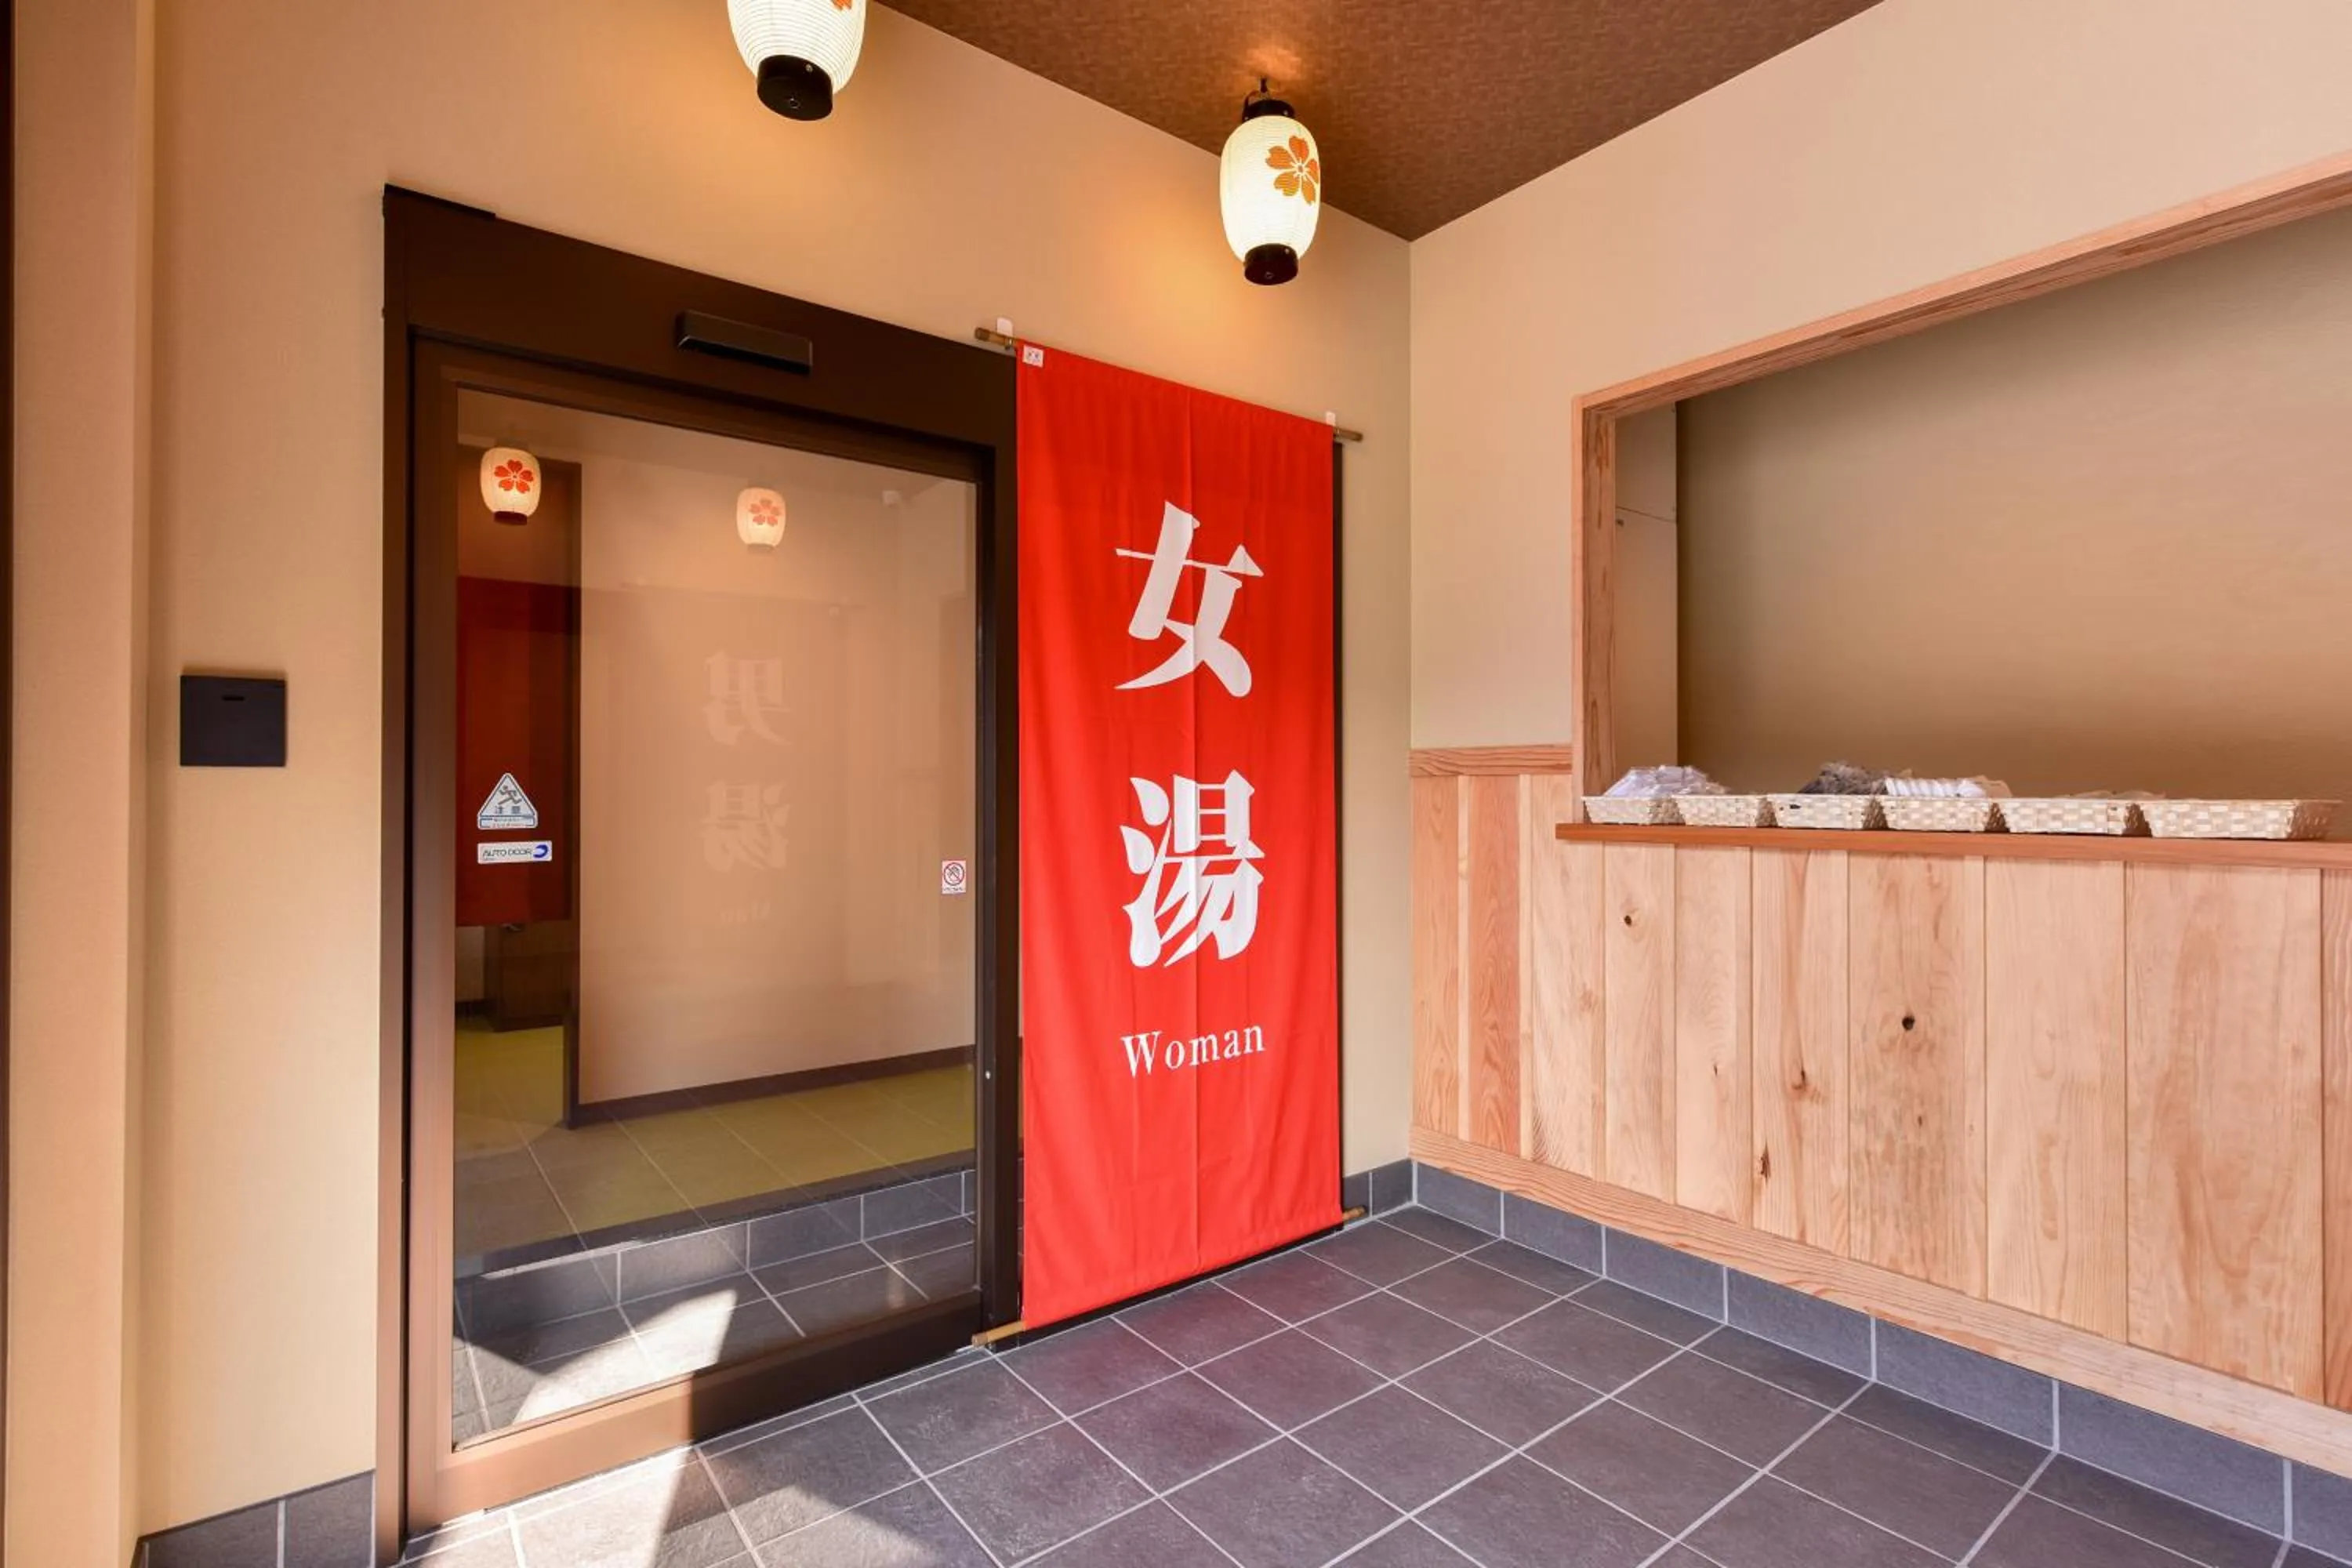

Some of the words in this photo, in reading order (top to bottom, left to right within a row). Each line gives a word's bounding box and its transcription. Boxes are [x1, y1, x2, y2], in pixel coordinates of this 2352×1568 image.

[1114, 500, 1265, 967] 女湯
[482, 848, 506, 857] AUTO
[508, 847, 532, 856] DOOR
[1121, 1024, 1265, 1077] Woman
